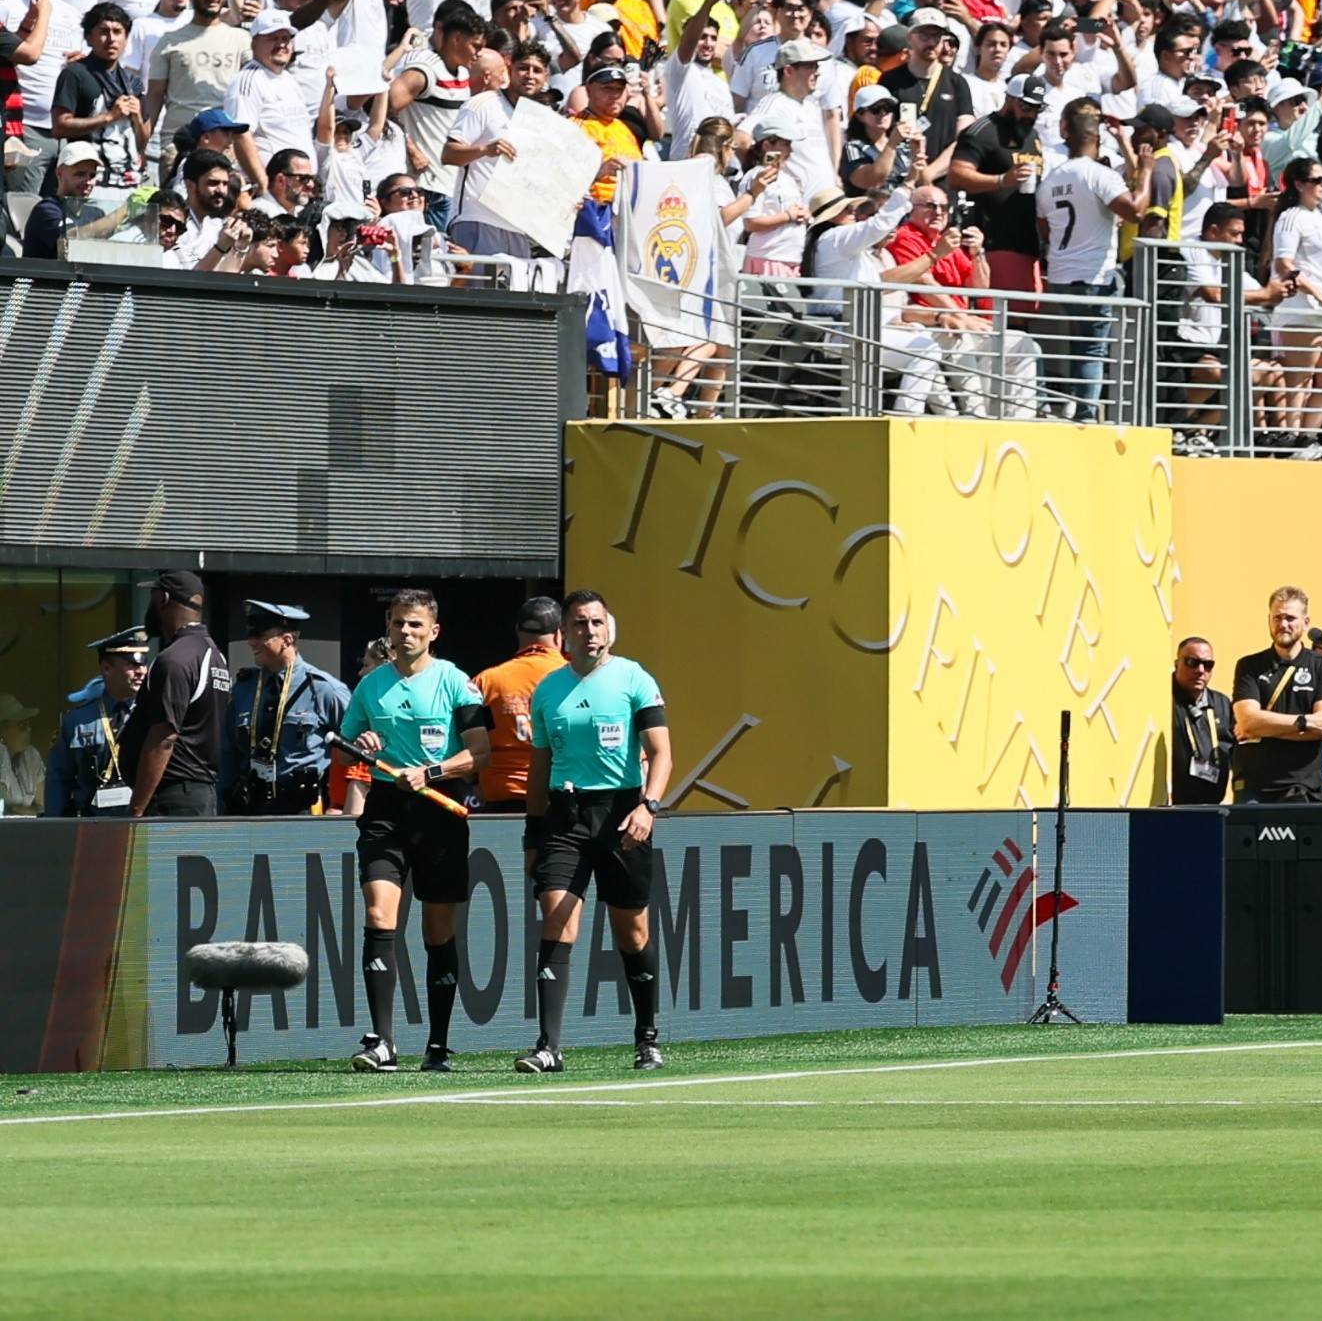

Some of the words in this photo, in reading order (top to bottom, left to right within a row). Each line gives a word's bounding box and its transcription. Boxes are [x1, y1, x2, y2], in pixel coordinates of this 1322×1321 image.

[180, 51, 234, 68] BOSS
[1055, 199, 1076, 251] 7
[421, 725, 444, 737] FIFA
[600, 725, 622, 736] FIFA
